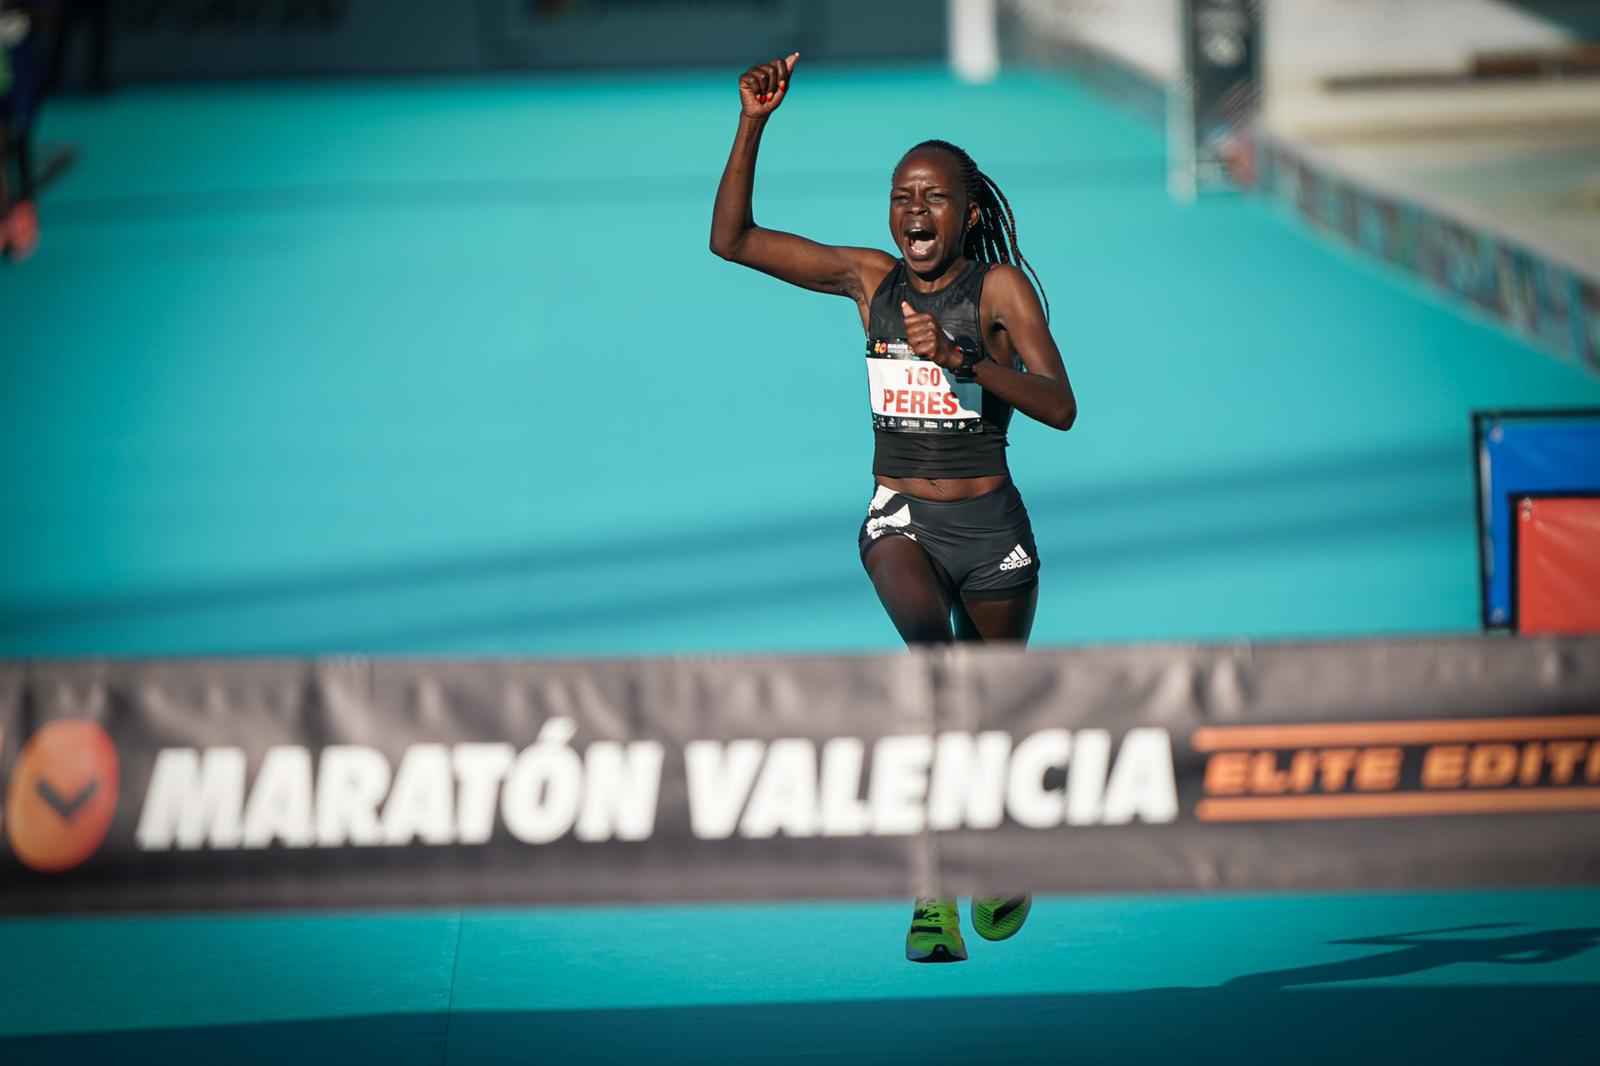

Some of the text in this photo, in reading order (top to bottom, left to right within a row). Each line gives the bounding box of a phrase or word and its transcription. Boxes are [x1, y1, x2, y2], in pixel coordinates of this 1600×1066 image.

[905, 367, 941, 386] 160
[883, 388, 958, 415] PERES
[1000, 556, 1032, 571] adidas
[137, 717, 1179, 850] MARATÓN VALENCIA
[1204, 746, 1404, 794] ELITE
